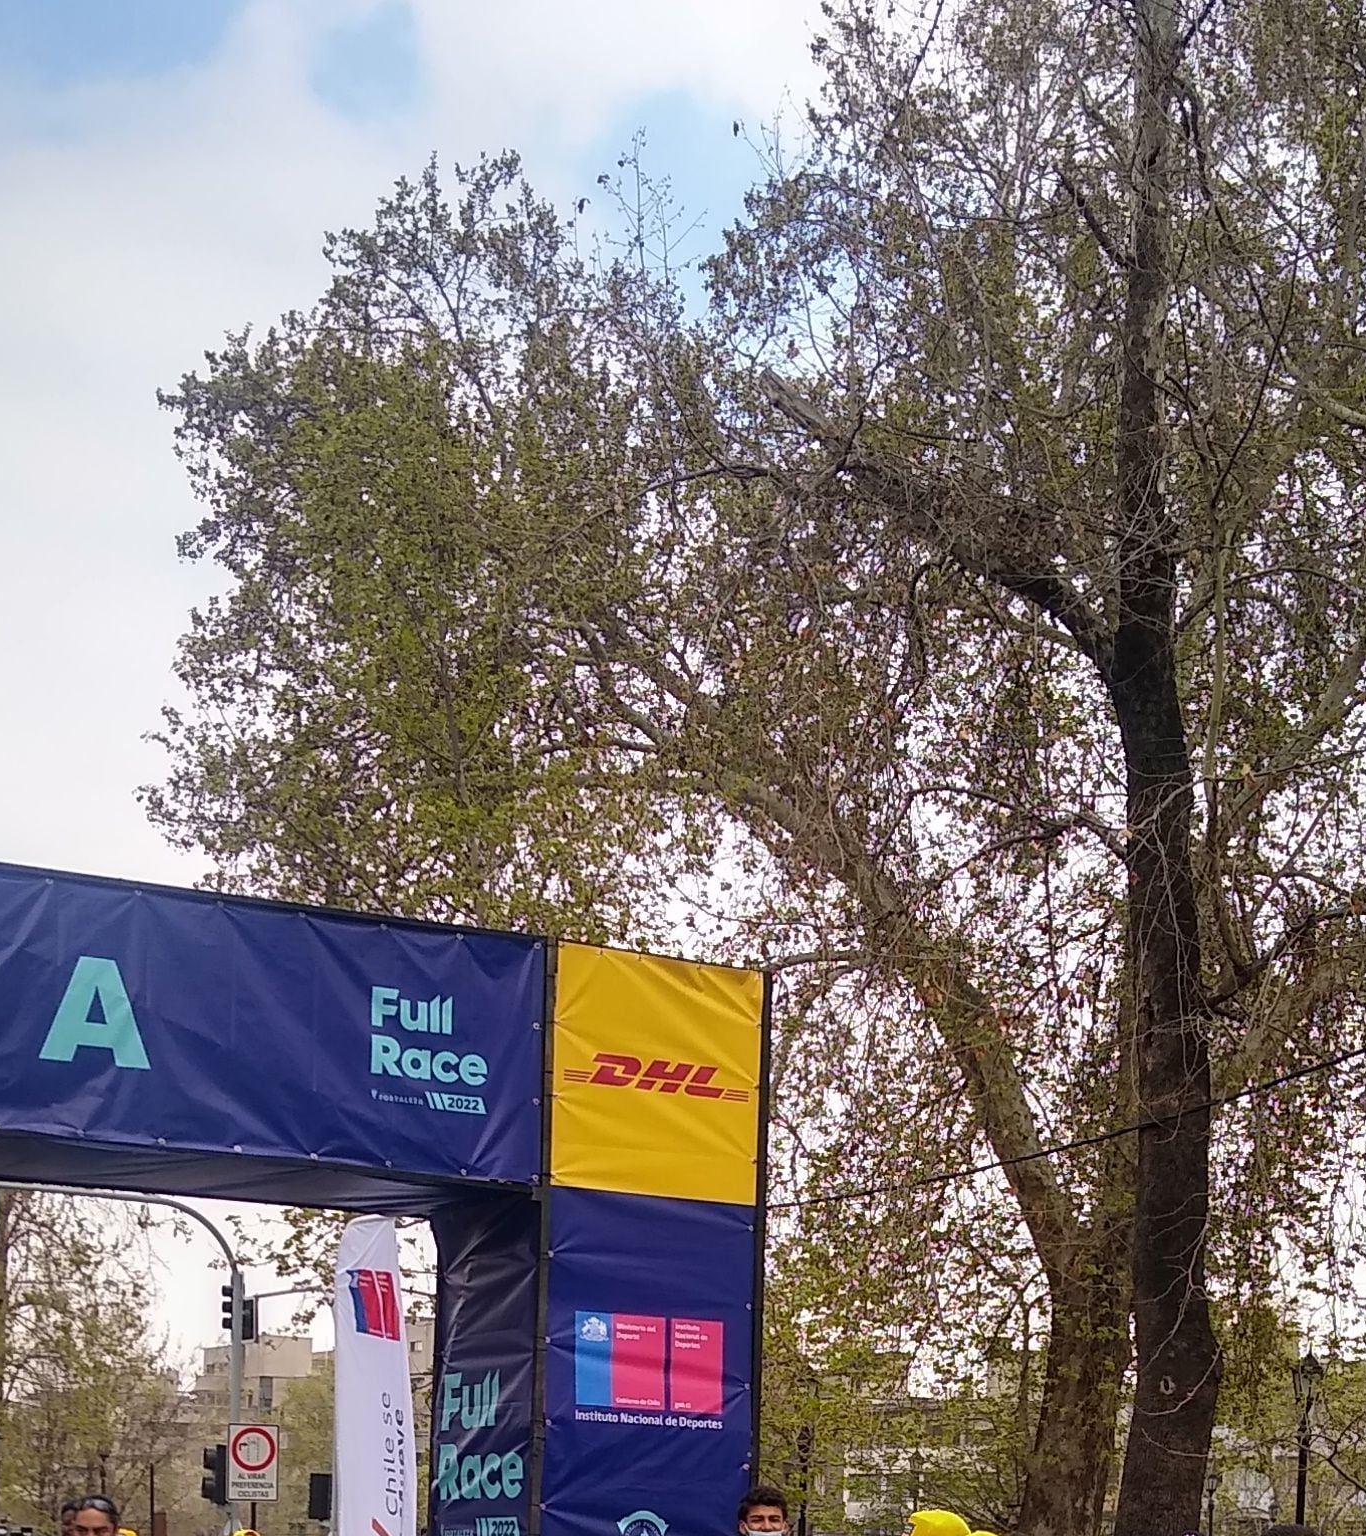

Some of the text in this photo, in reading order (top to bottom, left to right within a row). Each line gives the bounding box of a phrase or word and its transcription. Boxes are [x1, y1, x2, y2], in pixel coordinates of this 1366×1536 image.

[370, 985, 454, 1035] Full
[370, 1034, 489, 1087] Race
[589, 1052, 725, 1099] DHL
[447, 1097, 480, 1111] 2022
[440, 1368, 500, 1431] Full
[575, 1410, 723, 1430] Instituto Nacional de Deportes
[231, 1481, 274, 1489] PREFERENCIA
[383, 1437, 399, 1516] Chile
[437, 1443, 523, 1500] Race
